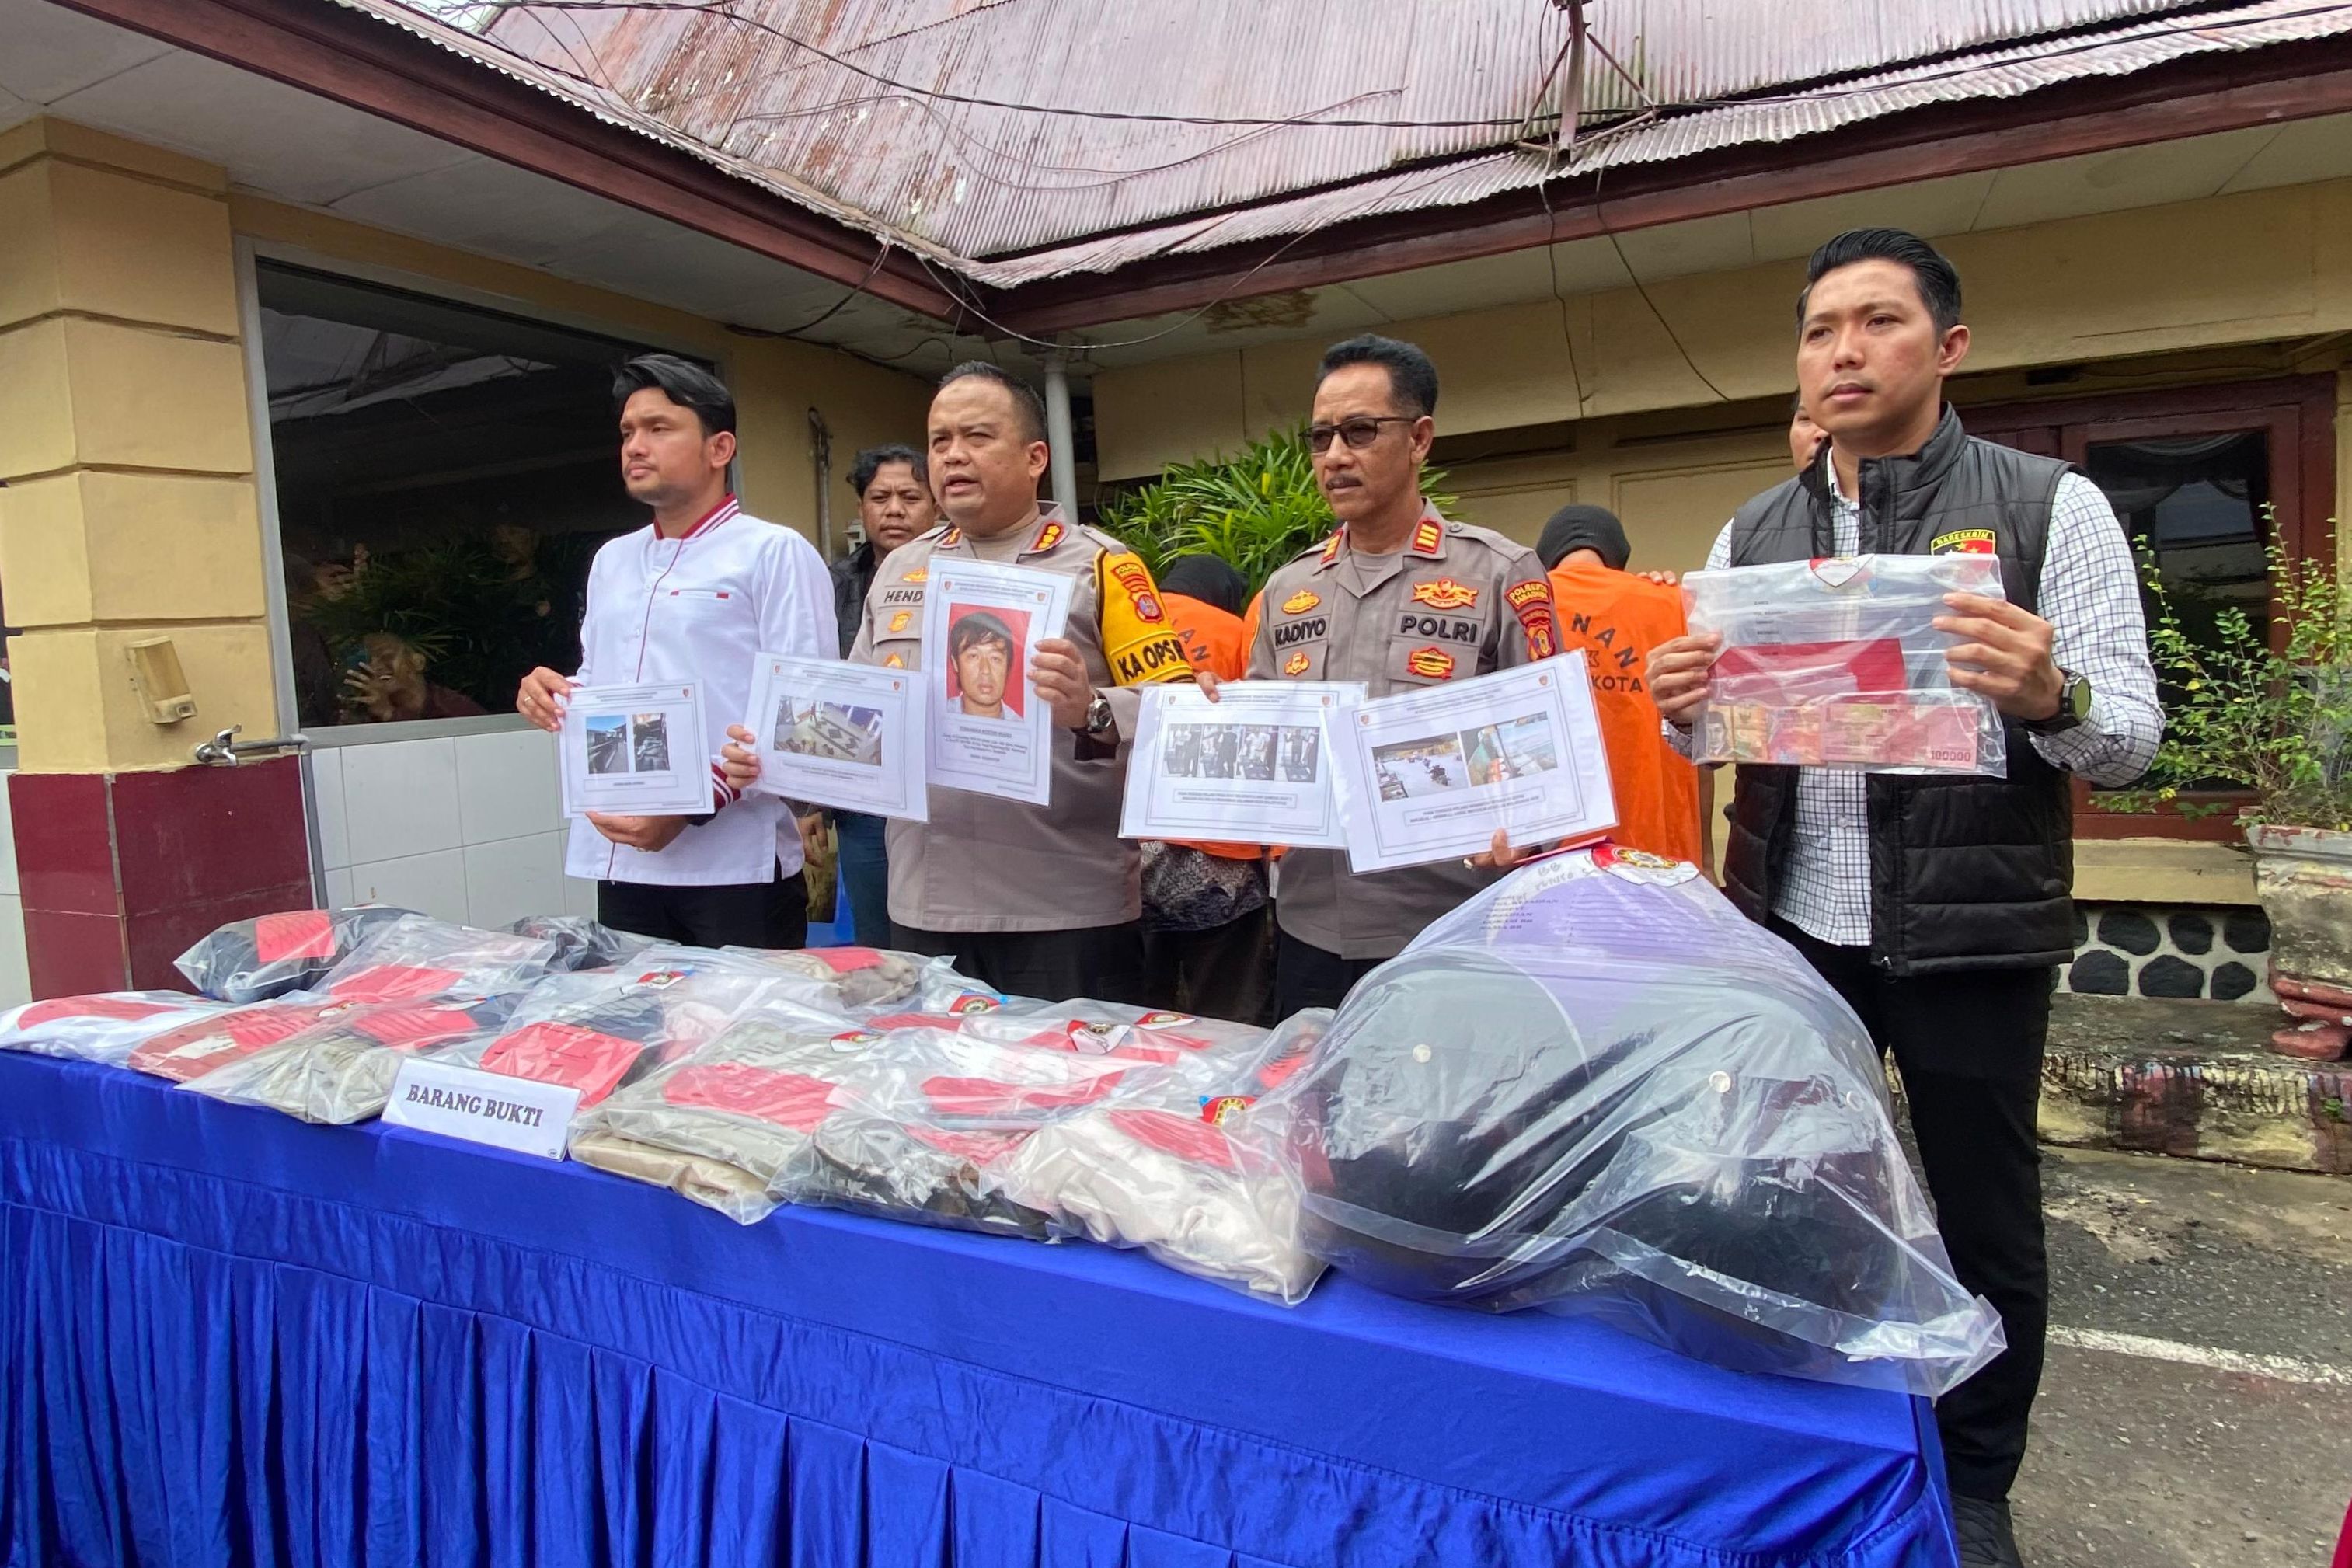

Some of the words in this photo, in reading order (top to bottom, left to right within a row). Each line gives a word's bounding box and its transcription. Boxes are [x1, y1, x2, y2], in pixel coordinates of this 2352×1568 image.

[1274, 618, 1326, 647] KADIYO
[1400, 615, 1477, 643] POLRI
[1117, 653, 1145, 682] KA
[1591, 675, 1643, 692] KOTA
[1930, 751, 1971, 762] 100000
[406, 1084, 481, 1113] BARANG
[483, 1099, 544, 1127] BUKTI
